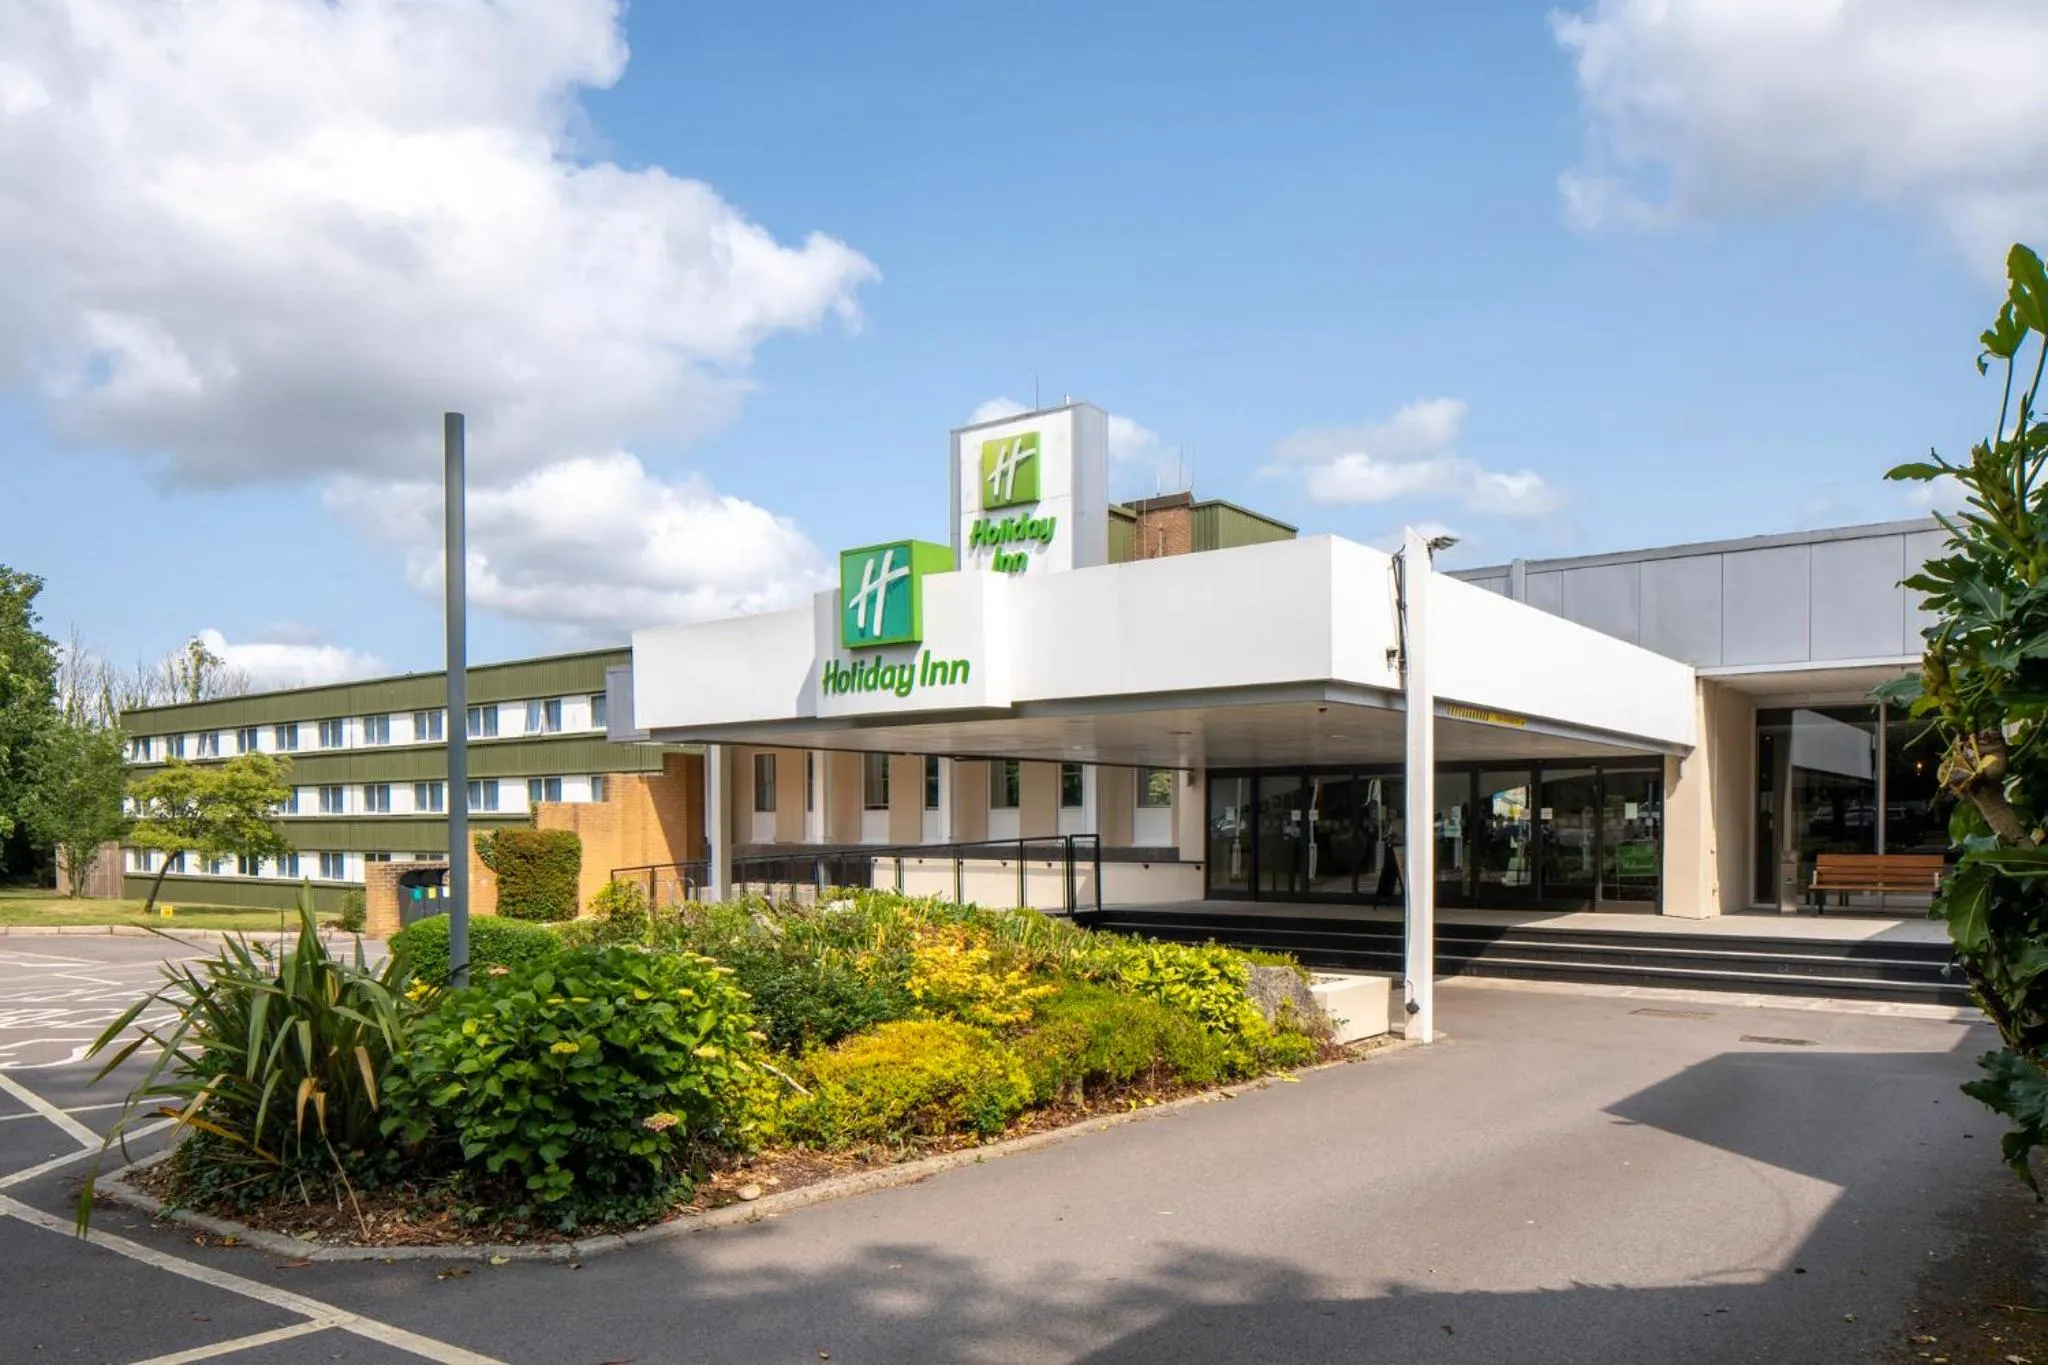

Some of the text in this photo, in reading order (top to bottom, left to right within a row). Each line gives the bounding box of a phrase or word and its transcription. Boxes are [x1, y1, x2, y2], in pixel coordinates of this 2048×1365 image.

[970, 513, 1056, 547] Holiday
[992, 548, 1028, 574] Inn
[822, 650, 970, 697] Holiday Inn
